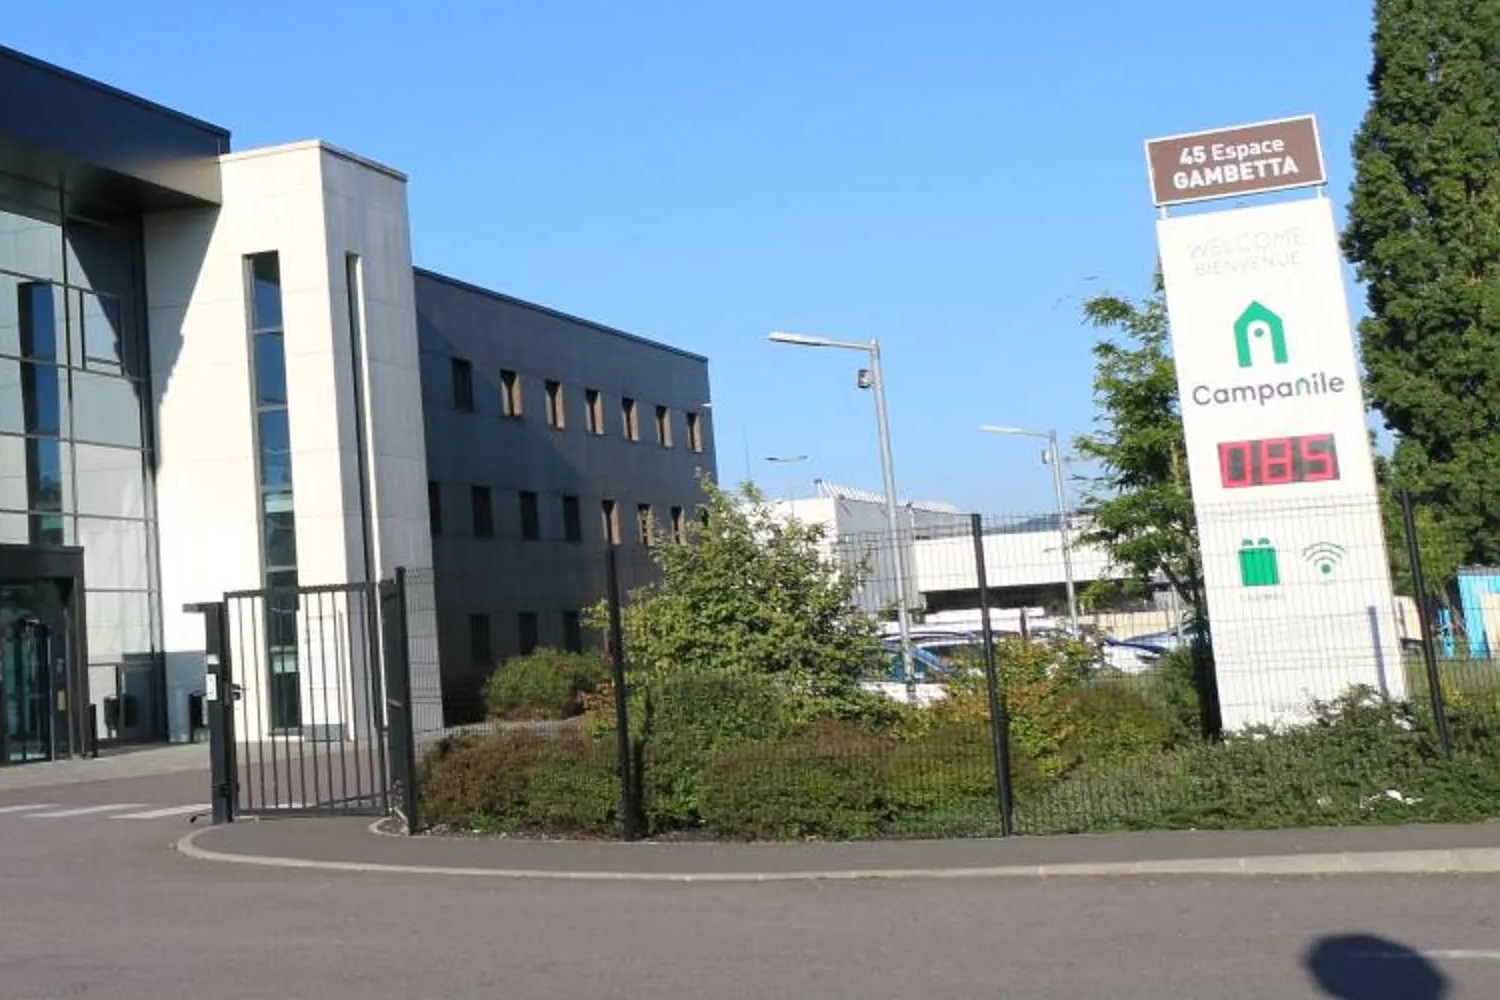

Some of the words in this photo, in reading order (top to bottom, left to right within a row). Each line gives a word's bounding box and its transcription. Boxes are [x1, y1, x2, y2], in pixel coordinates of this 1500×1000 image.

[1178, 146, 1206, 165] 45
[1211, 138, 1285, 161] Espace
[1173, 156, 1299, 190] GAMBETTA
[1187, 227, 1307, 257] WELCOME
[1195, 251, 1302, 277] BIENVENUE
[1192, 371, 1345, 406] Campanile
[1219, 434, 1337, 488] 085
